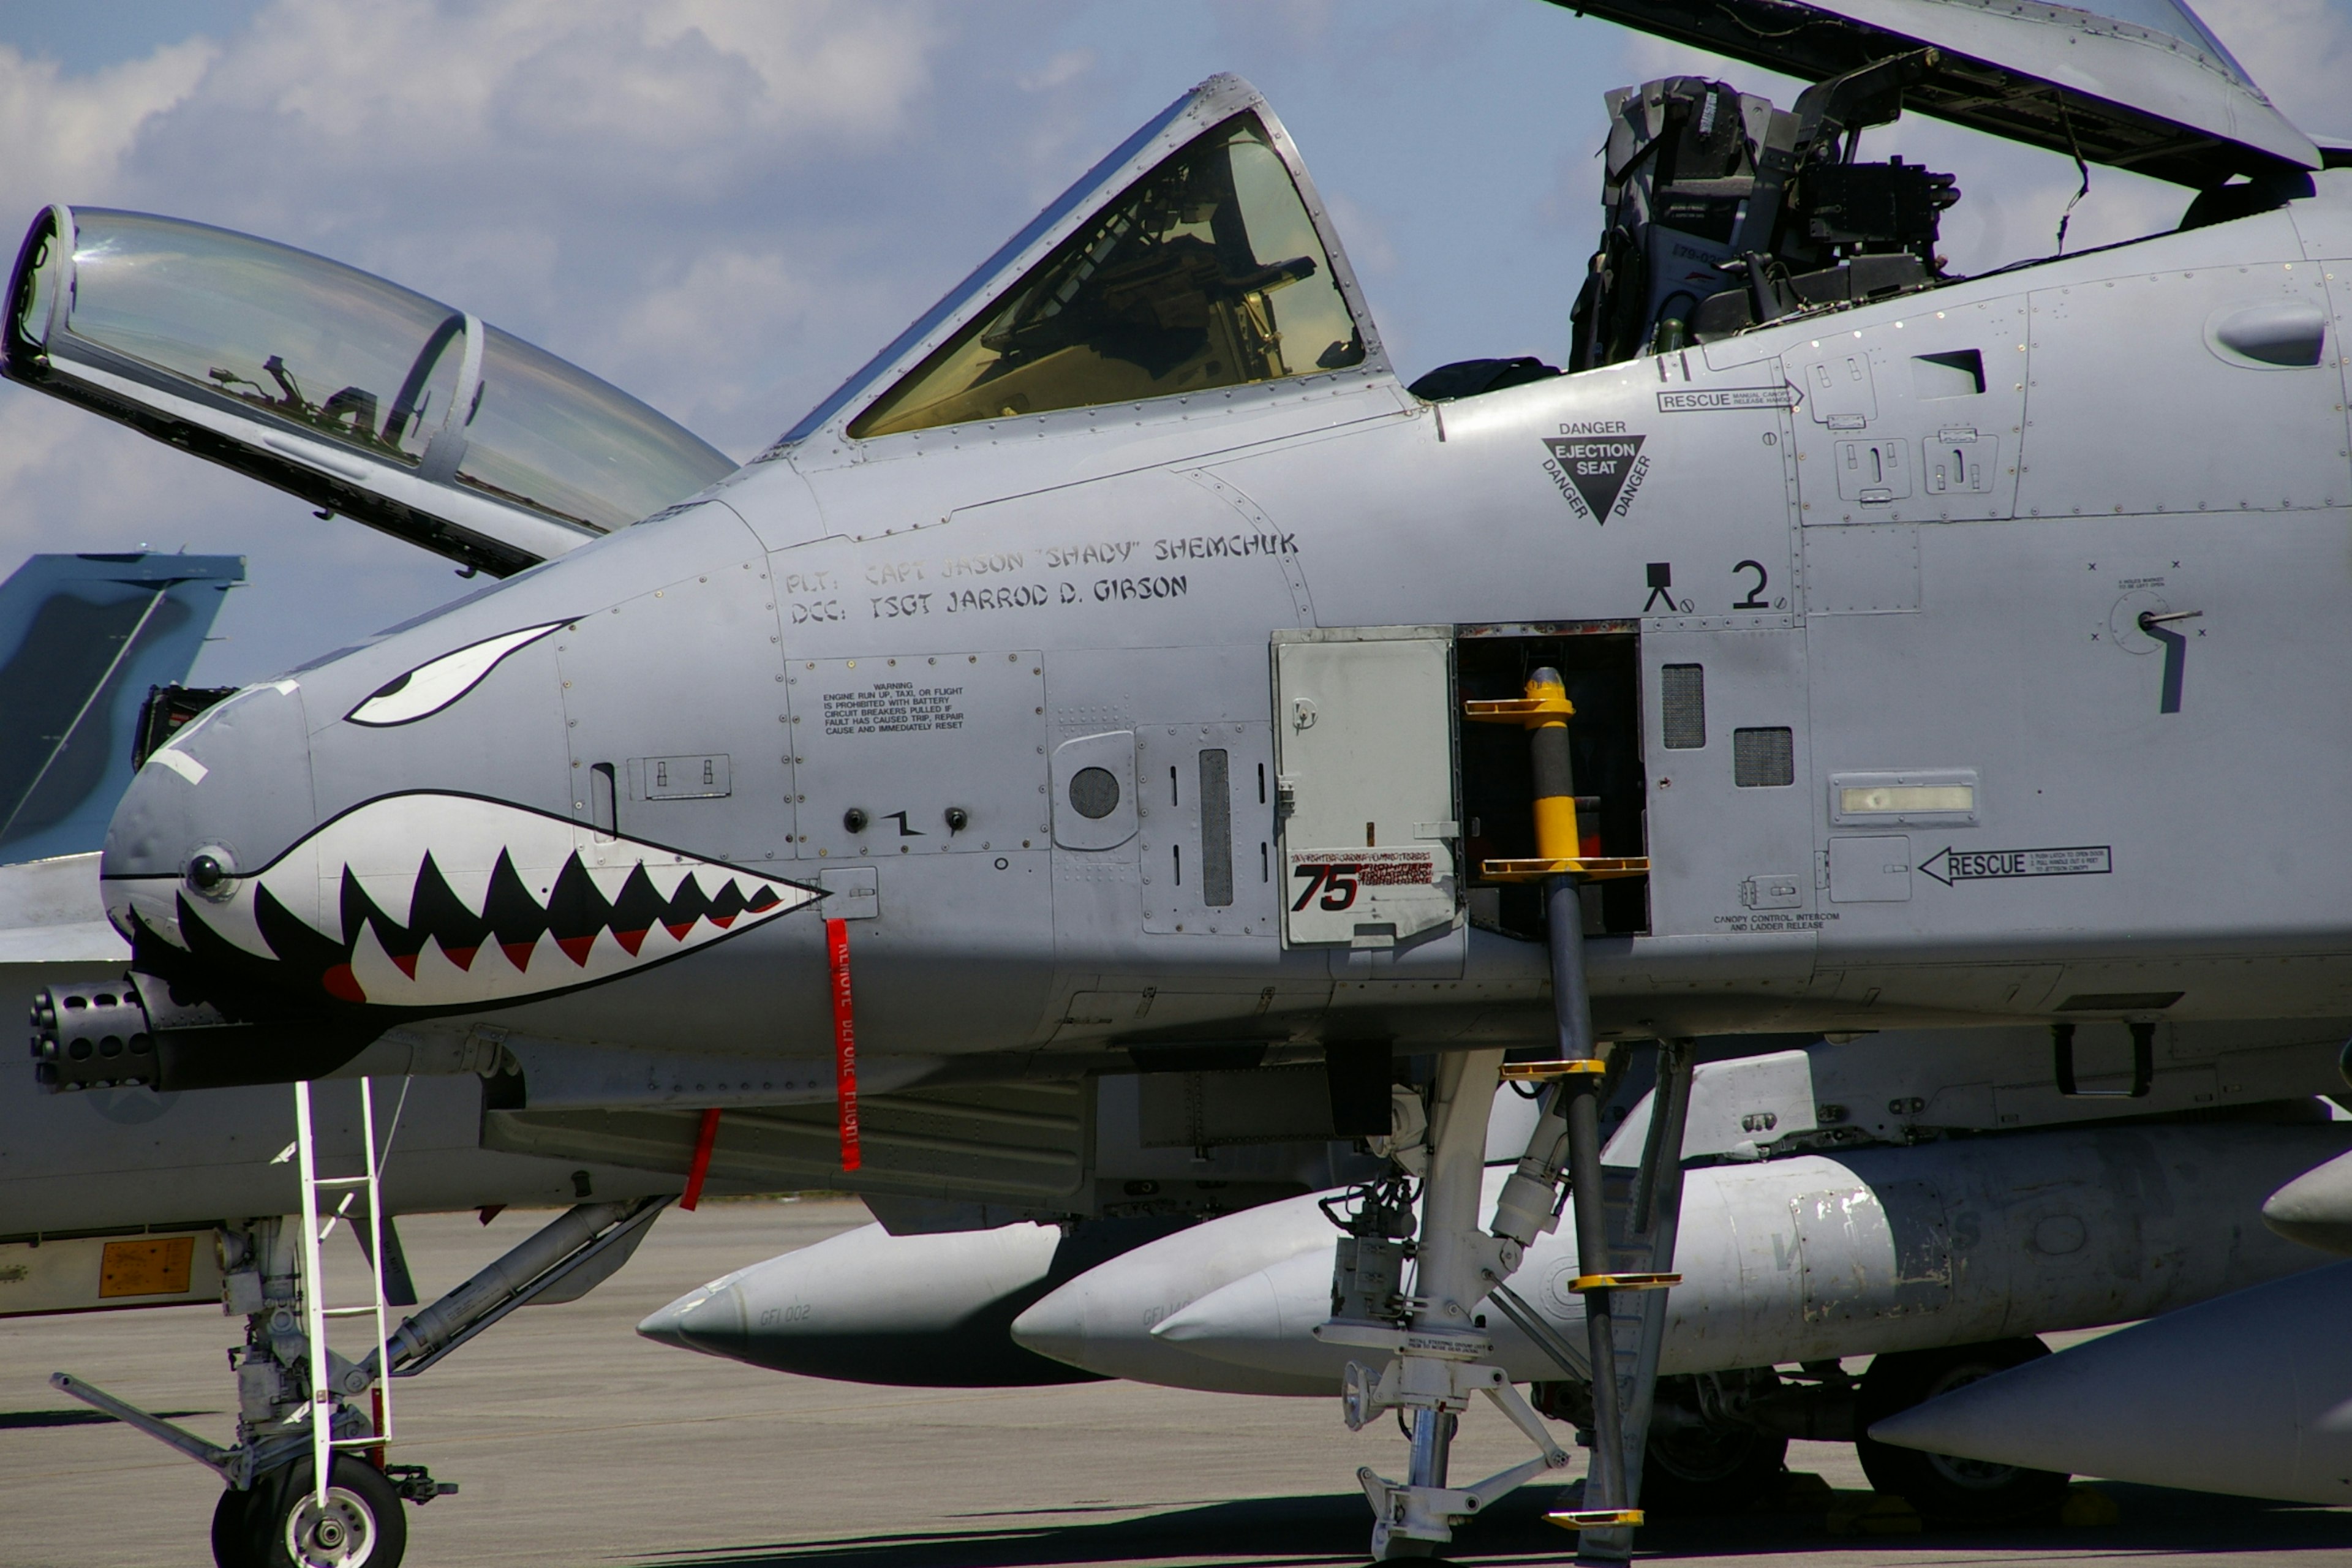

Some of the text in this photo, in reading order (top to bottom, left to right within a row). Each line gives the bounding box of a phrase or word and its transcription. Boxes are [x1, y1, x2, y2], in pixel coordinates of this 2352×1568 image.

[1664, 393, 1731, 408] RESCUE
[1559, 421, 1627, 435] DANGER
[1555, 442, 1636, 458] EJECTION
[1577, 461, 1618, 475] SEAT
[1541, 458, 1589, 521] DANGER
[1613, 454, 1651, 518] DANGER
[786, 533, 1299, 593] PLT: CAPT JASON "SHADY" SHEMCHUK
[792, 575, 1188, 624] DCC: TSGT JARROD D. GIBSON
[824, 709, 858, 718] CIRCUIT
[861, 707, 907, 716] BREAKERS
[835, 700, 885, 709] PROHIBITED
[826, 726, 854, 735] CAUSE
[878, 723, 932, 732] IMMEDIATELY
[1949, 854, 2026, 875] RESCUE
[1291, 864, 1360, 911] 75
[1714, 914, 1748, 924] CANOPY
[1796, 913, 1840, 922] INTERCOM
[1730, 921, 1825, 932] AND LADDER RELEASE
[838, 943, 852, 1007] REMOVE
[760, 1309, 780, 1326] GFI
